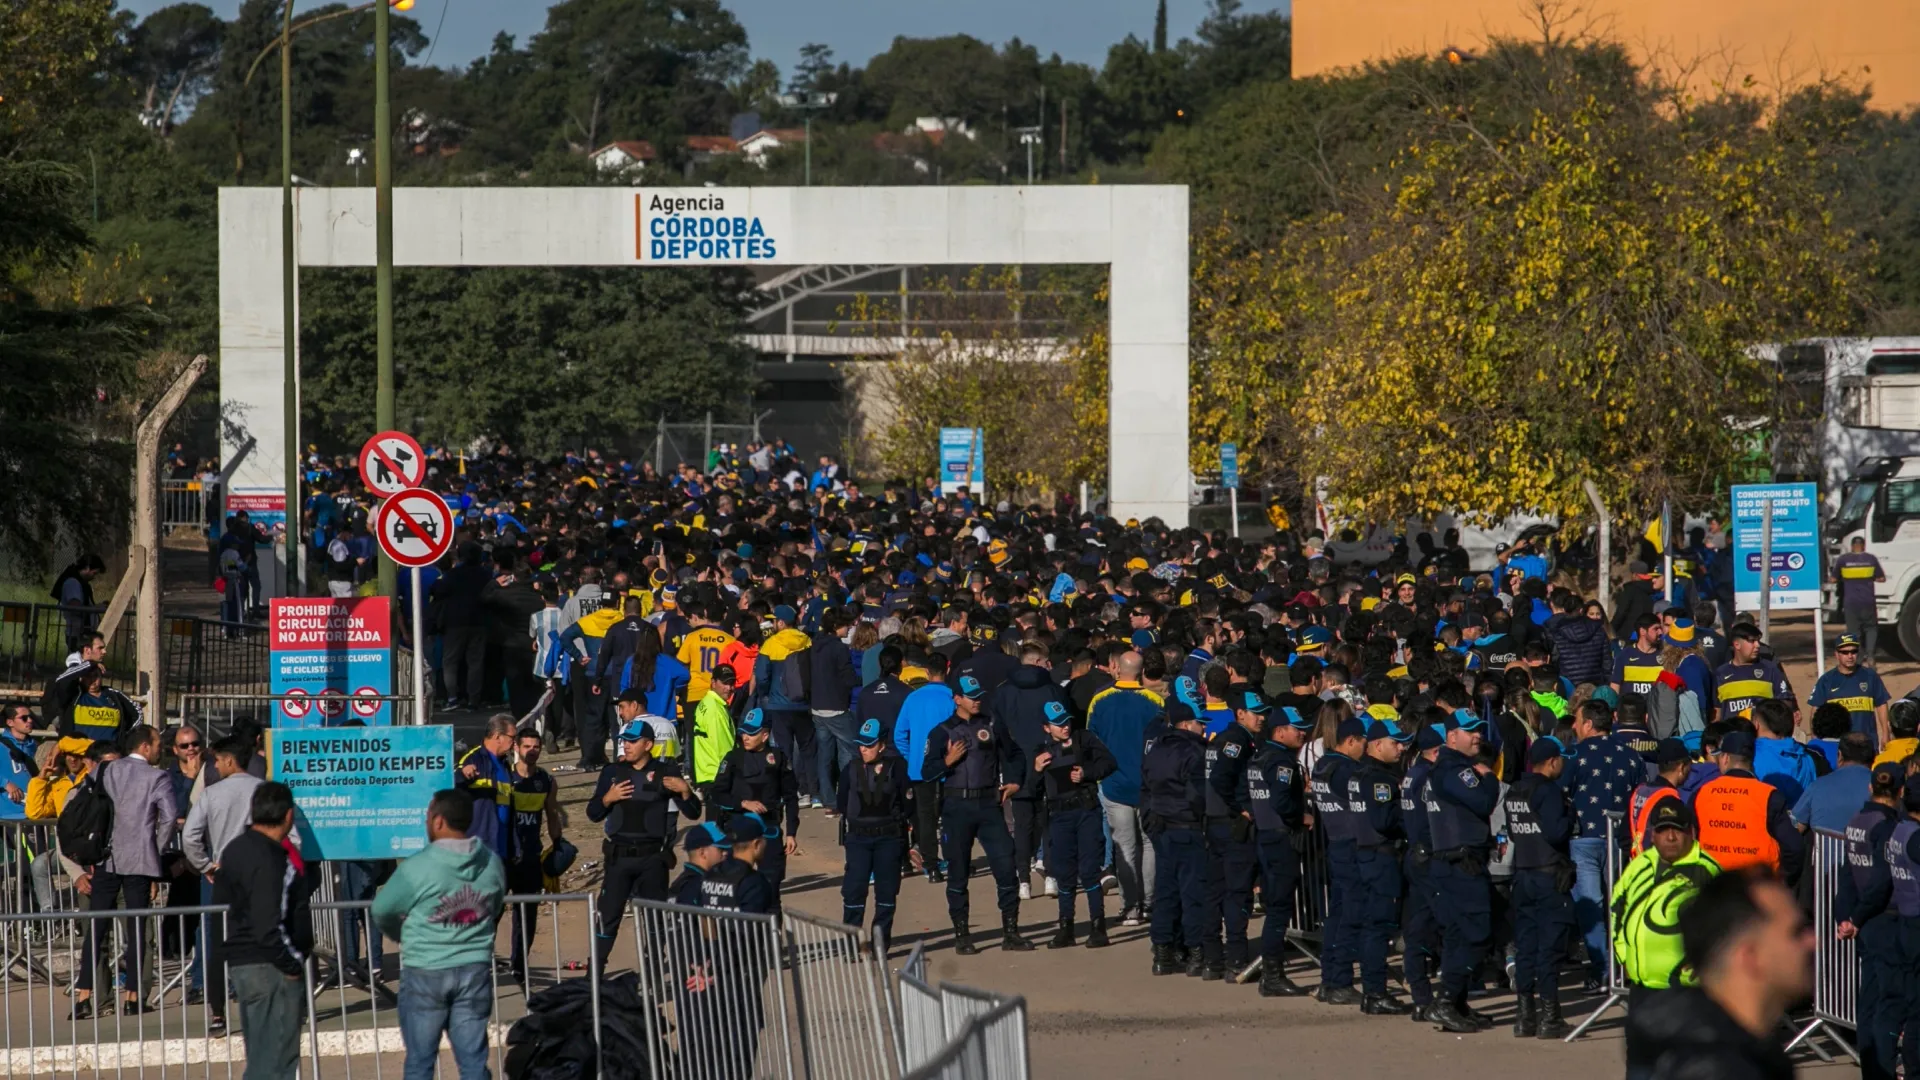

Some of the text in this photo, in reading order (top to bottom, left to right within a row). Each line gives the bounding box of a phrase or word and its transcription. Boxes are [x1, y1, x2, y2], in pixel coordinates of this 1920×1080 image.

[649, 194, 724, 215] Agencia
[650, 213, 765, 238] CÓRDOBA
[651, 238, 776, 259] DEPORTES
[1736, 489, 1804, 498] CONDICIONES DE
[1772, 498, 1810, 506] CIRCUITO
[1737, 508, 1748, 517] DE
[278, 605, 348, 617] PROHIBIDA
[278, 615, 364, 630] CIRCULACIÓN
[279, 631, 381, 642] NO AUTORIZADA
[281, 654, 382, 664] CIRCUITO USO EXCLUSIVO
[700, 645, 720, 673] 10
[281, 665, 334, 674] DE CICLISTAS
[88, 709, 115, 718] QATAR
[282, 738, 391, 755] BIENVENIDOS
[281, 755, 446, 773] AL ESTADIO KEMPES
[283, 775, 415, 788] Agencia Córdoba Deportes
[1711, 787, 1749, 795] POLICIA
[315, 810, 344, 818] ACCESO
[346, 808, 376, 817] DEBERÁ
[377, 807, 422, 817] PRESENTAR
[1721, 803, 1734, 811] DE
[314, 819, 324, 827] DE
[325, 818, 358, 827] INGRESO
[1709, 819, 1747, 830] CORDOBA
[1719, 845, 1731, 853] DEL
[701, 880, 733, 897] POLICIA
[709, 896, 719, 905] DE
